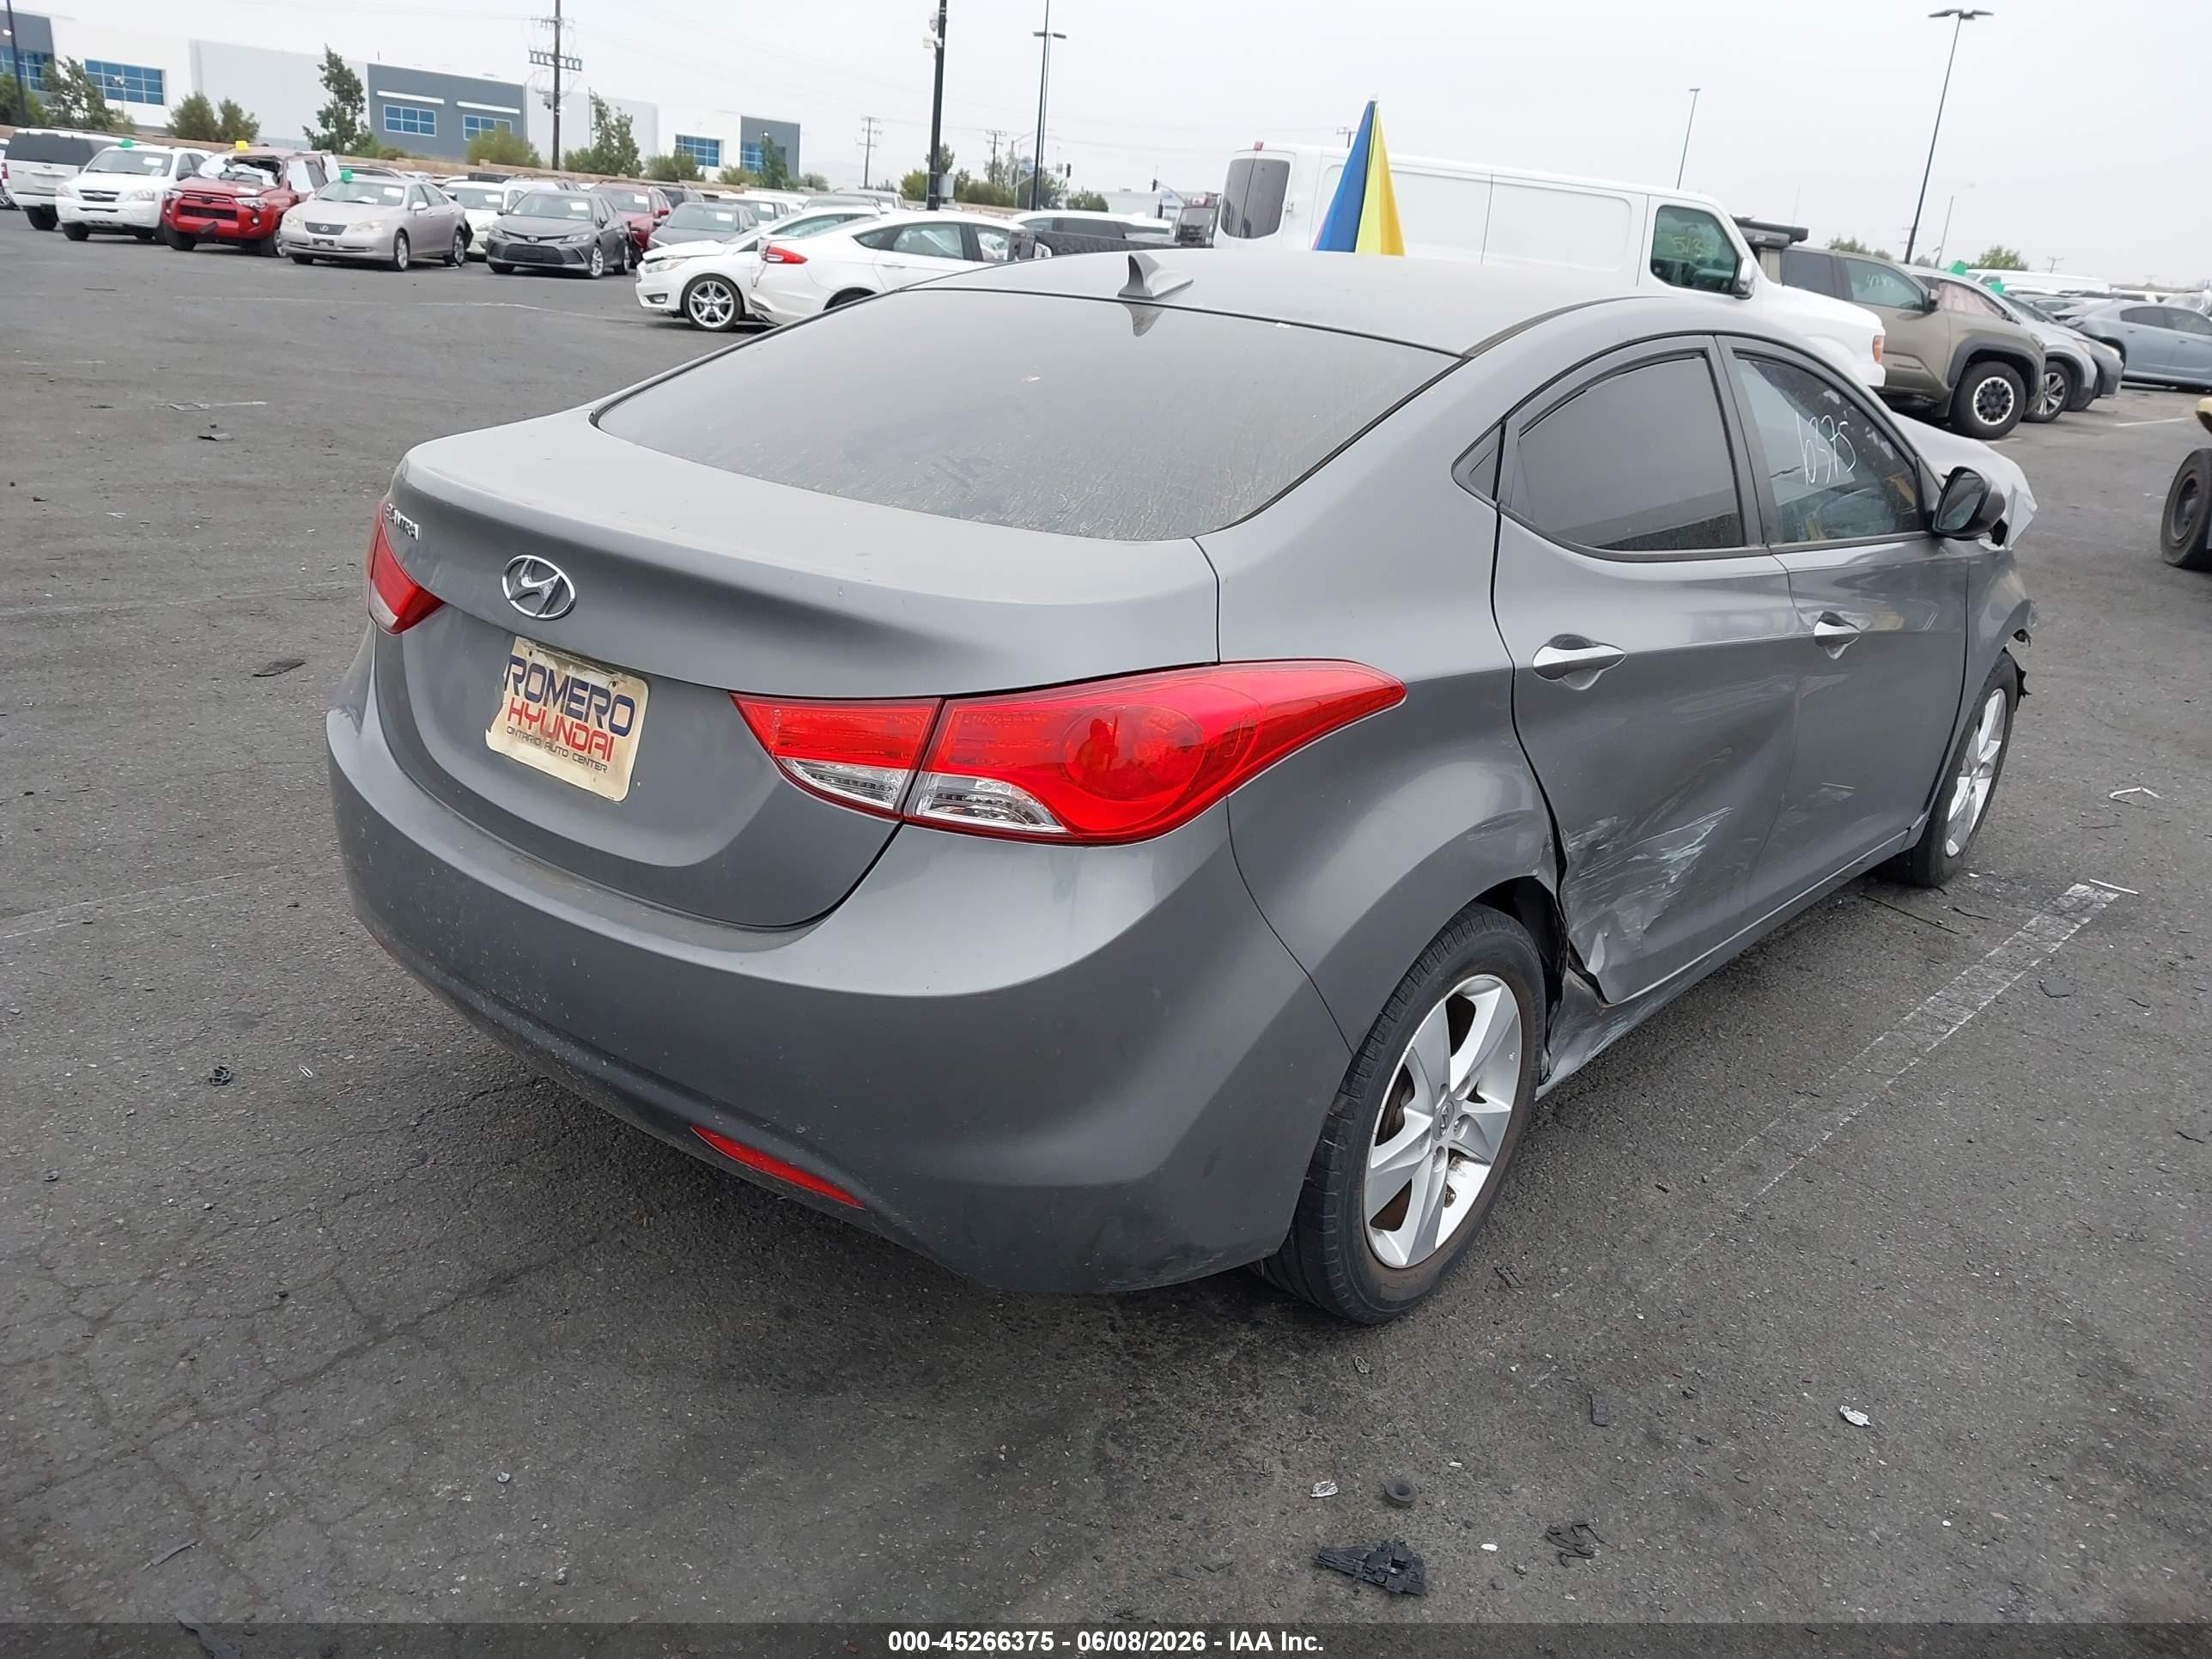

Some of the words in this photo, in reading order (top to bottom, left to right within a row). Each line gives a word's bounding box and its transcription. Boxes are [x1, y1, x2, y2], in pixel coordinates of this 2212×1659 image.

[1795, 411, 1857, 486] 6375
[503, 654, 635, 738] ROMERO
[507, 696, 616, 763] HYUNDAI
[507, 726, 542, 747] ONTARIO
[544, 740, 568, 758] AUTO
[572, 752, 608, 775] CENTER
